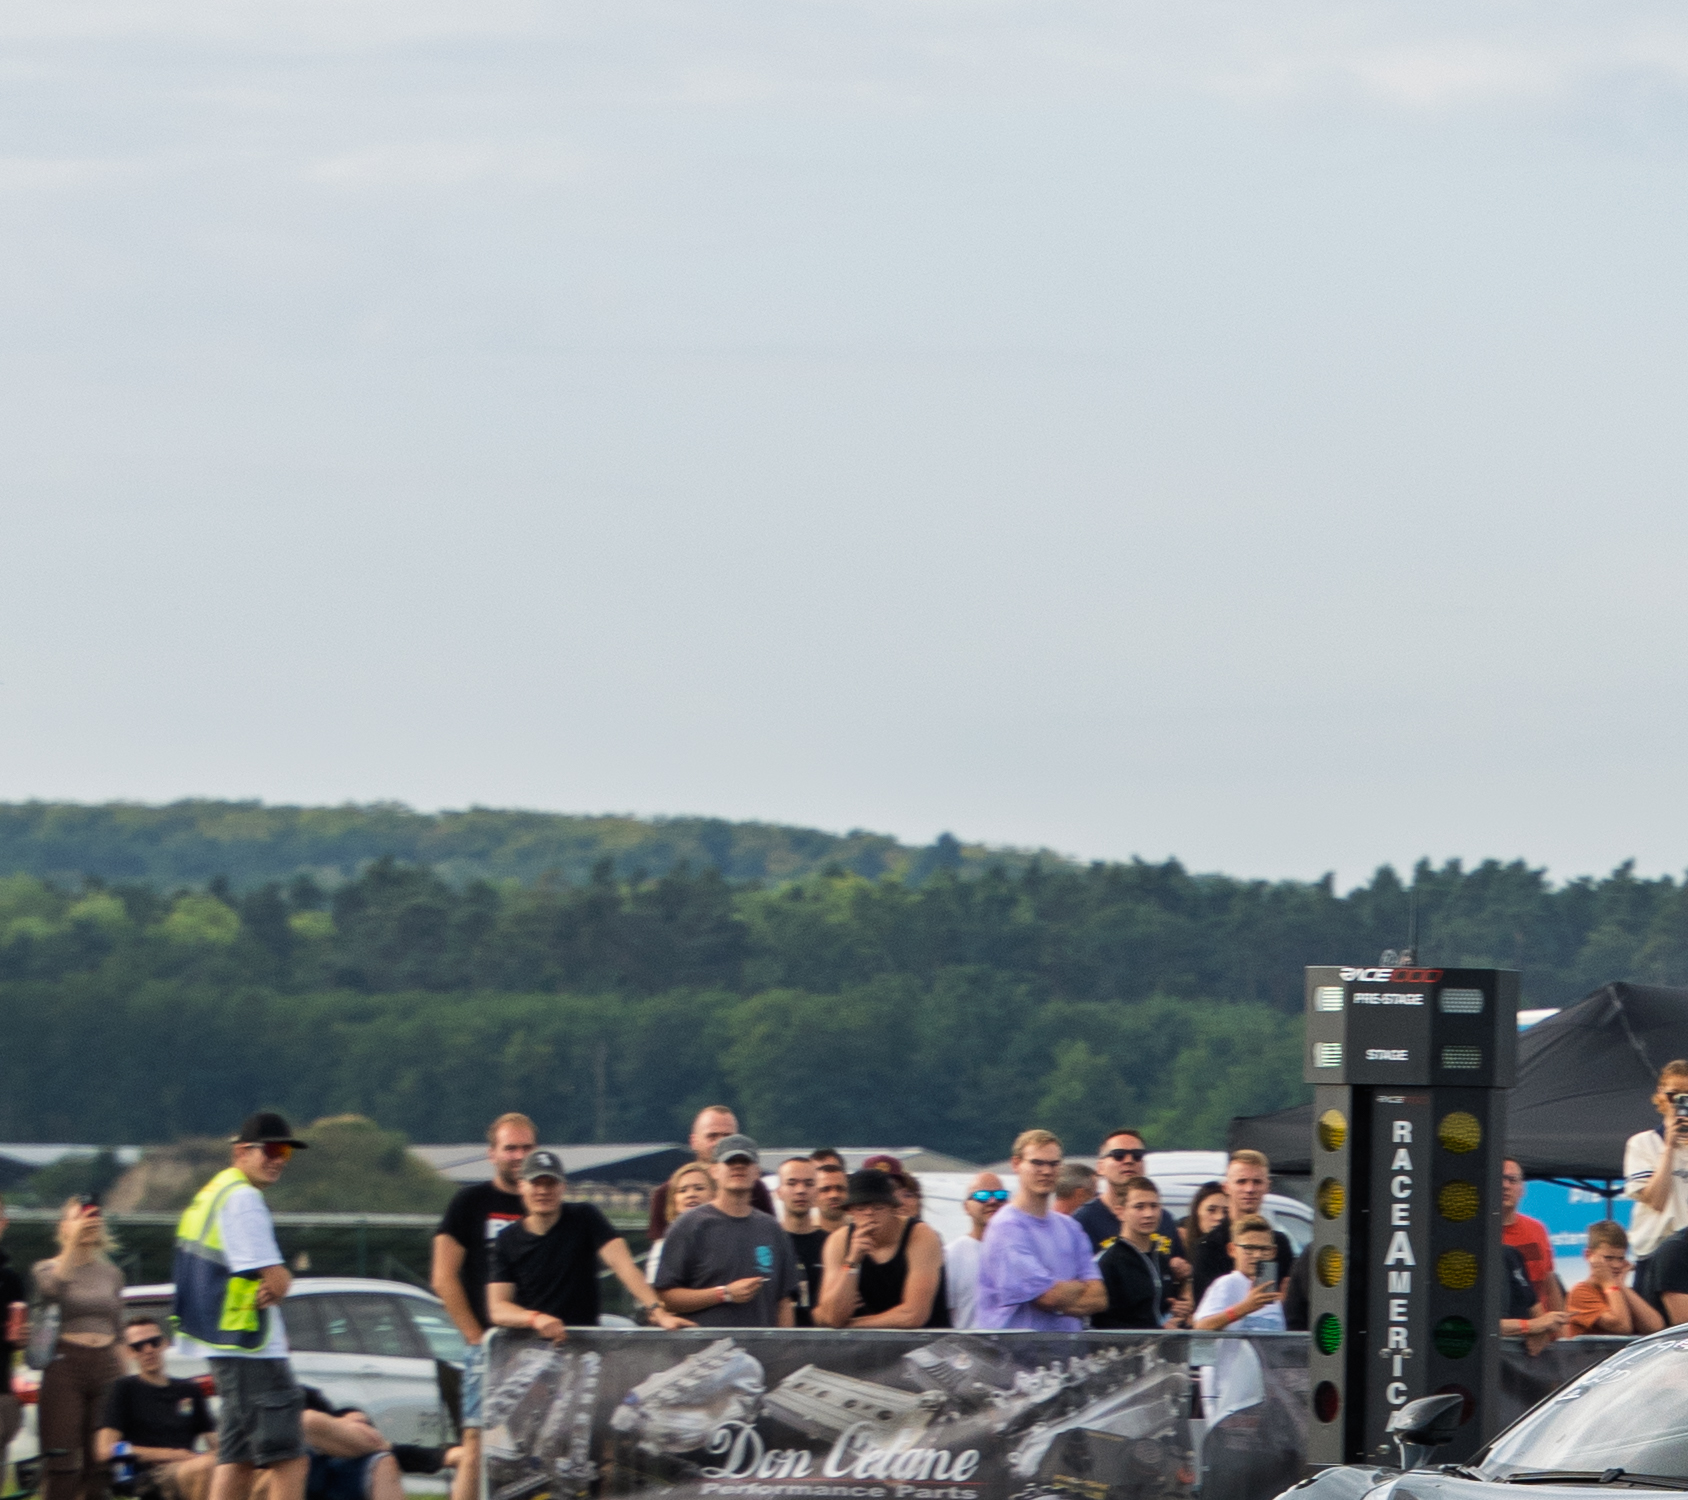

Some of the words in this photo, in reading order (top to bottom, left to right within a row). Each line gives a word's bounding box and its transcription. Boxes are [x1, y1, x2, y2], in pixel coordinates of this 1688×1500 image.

[1352, 992, 1425, 1005] PRE-STAGE
[1365, 1049, 1409, 1061] STAGE
[701, 1419, 815, 1479] Don
[700, 1481, 887, 1497] Performance
[895, 1486, 979, 1500] Parts
